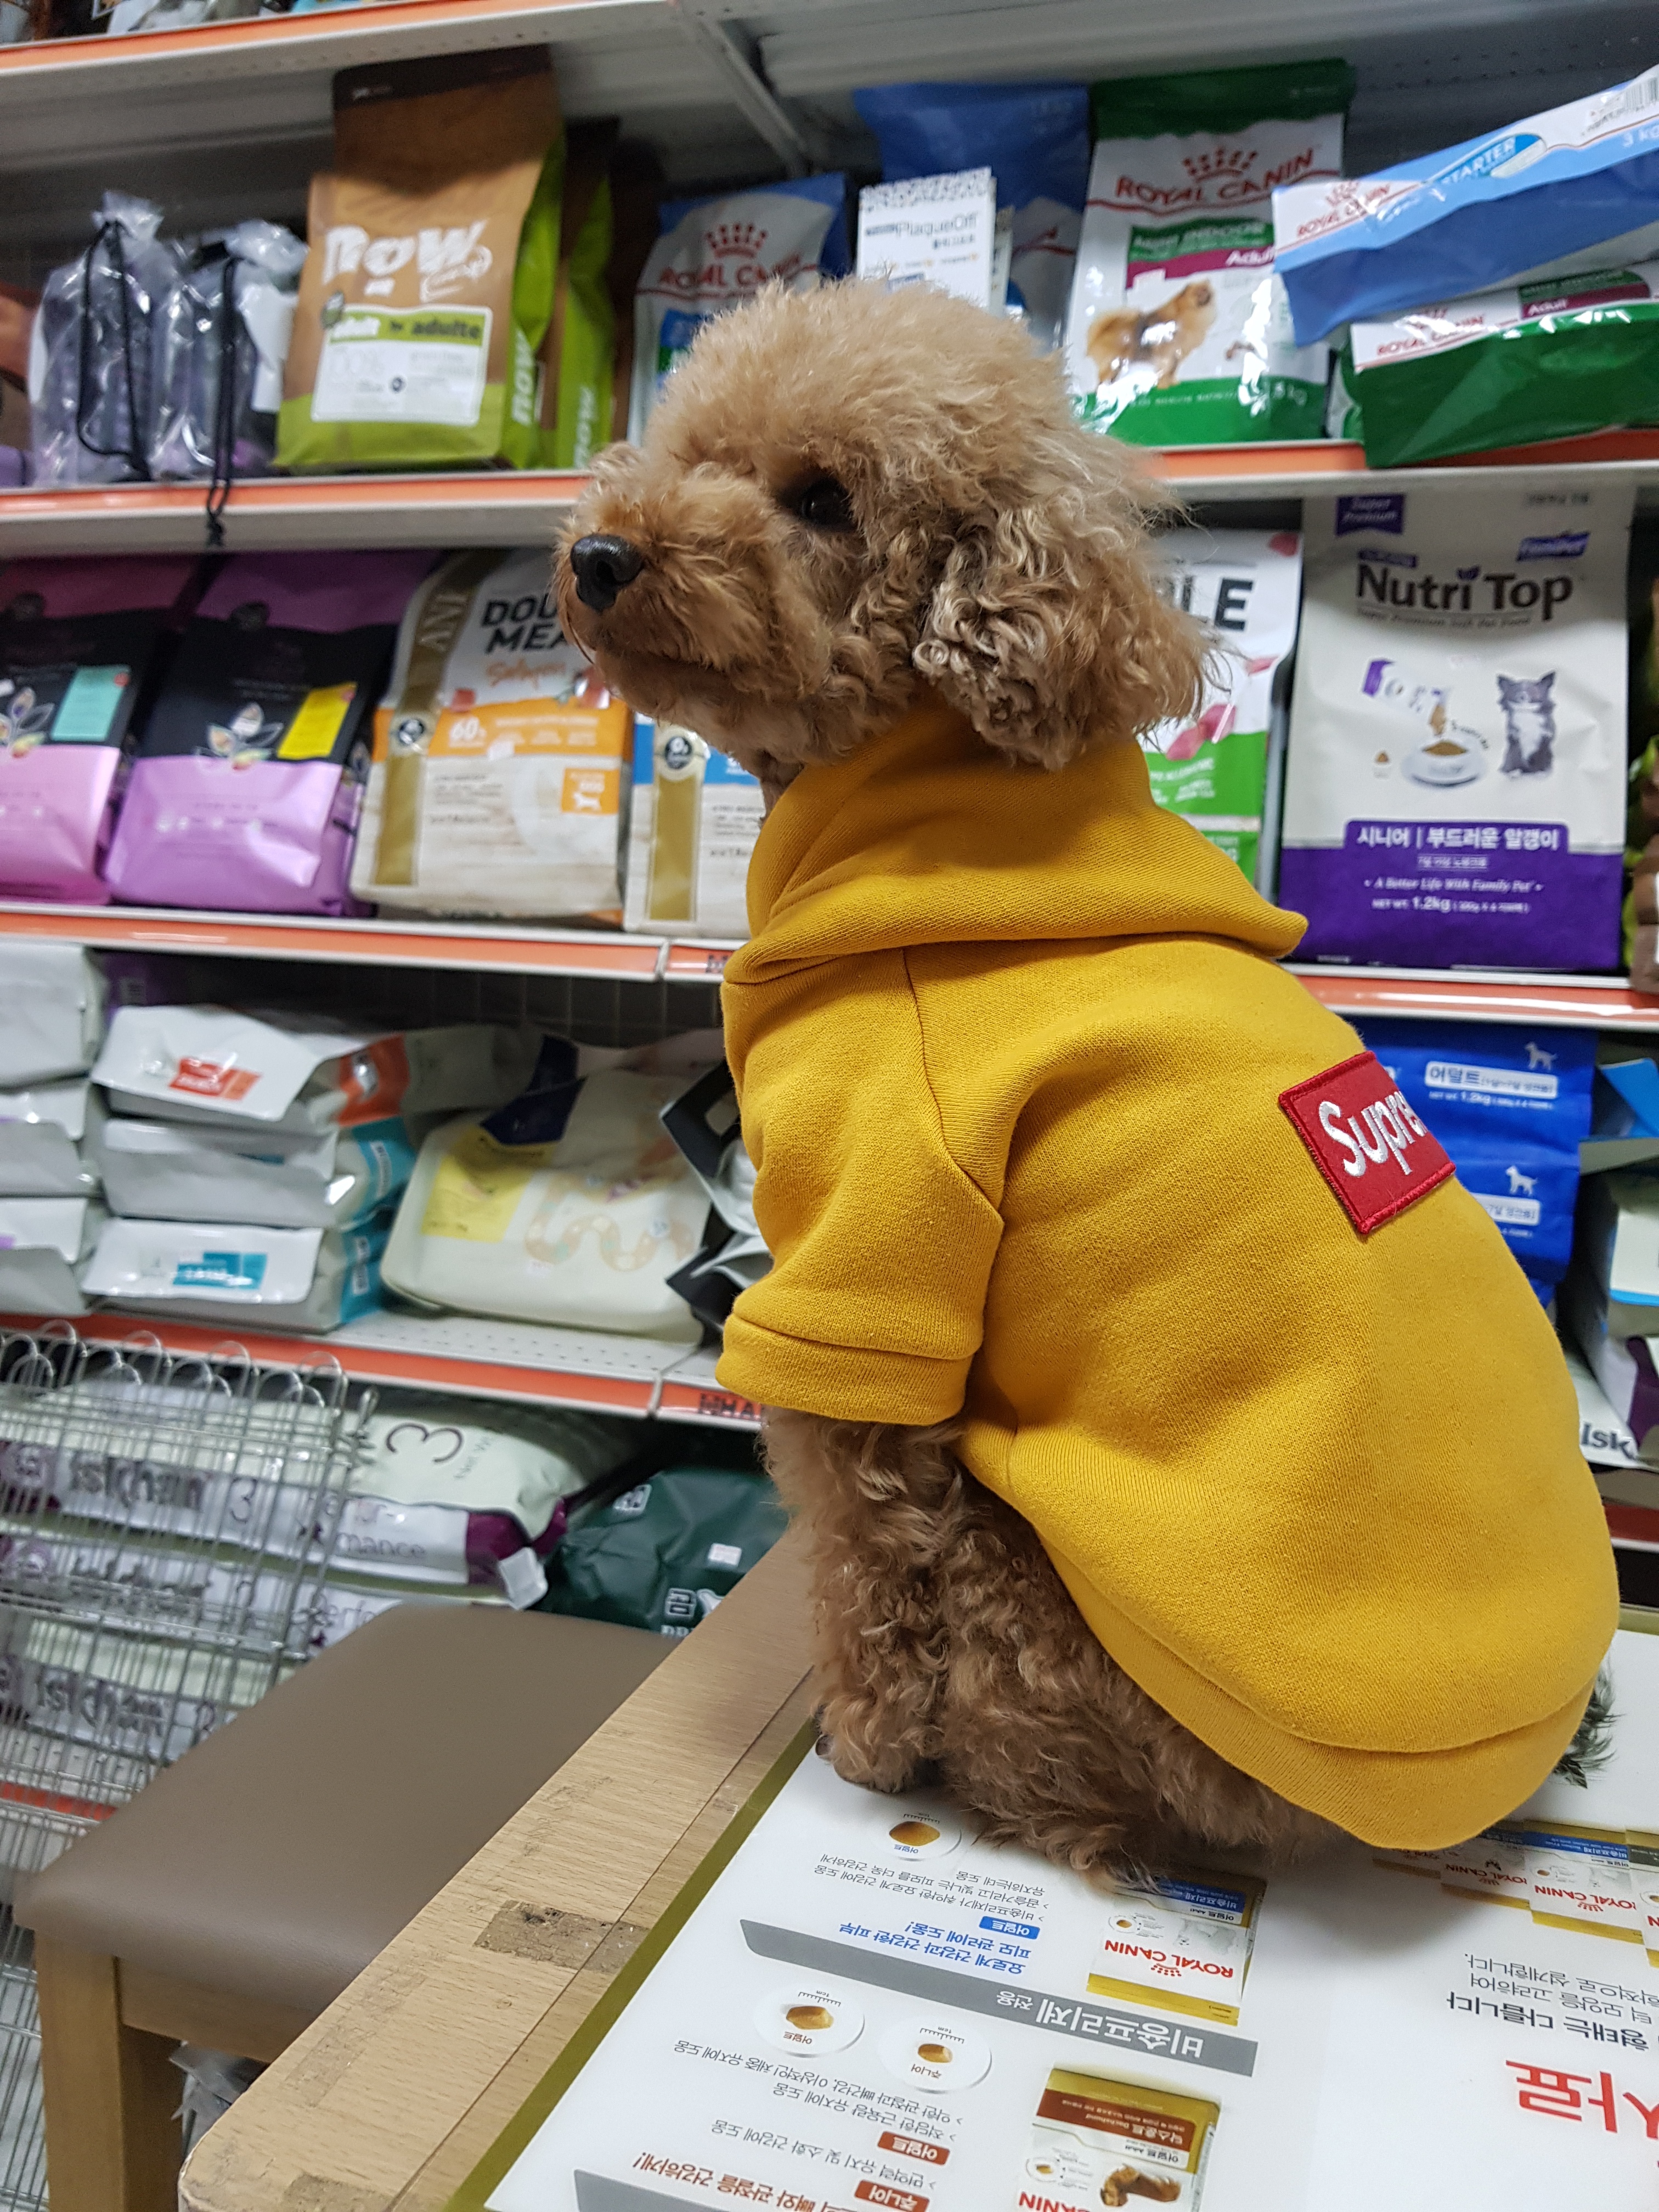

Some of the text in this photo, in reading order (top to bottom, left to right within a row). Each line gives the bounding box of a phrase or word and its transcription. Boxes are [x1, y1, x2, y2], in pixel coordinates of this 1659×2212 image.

[1217, 148, 1314, 199] CANIN
[1356, 563, 1573, 621] Nutri Top
[1357, 826, 1410, 849] 시니어
[1504, 828, 1559, 851] 알갱이
[1412, 896, 1452, 913] 1.2kg
[1429, 1066, 1481, 1085] 어덜트
[893, 1844, 919, 1854] 어덜트
[820, 1853, 1040, 1909] 곱슬거리고 빛나는 피모를 더욱 건강하게
[956, 1870, 1046, 1897] 유지하는데 도움
[1445, 1864, 1487, 1877] CANIN
[814, 1864, 1034, 1921] 비숑프리제가 취약한 요로계 건강에 도움
[1534, 1884, 1587, 1901] CANIN
[904, 1921, 1032, 1960] 피모 관리에 도움!
[991, 1920, 1031, 1937] 어덜트
[838, 1922, 1026, 1975] 요로계 건강과 건강한 피부
[1104, 1939, 1234, 1979] ROYAL CANIN
[1464, 1953, 1570, 1987] 설계합니다.
[1470, 1972, 1652, 2024] 턱 모양을 고려하여
[996, 1989, 1204, 2059] 비숑프리제 전용
[1446, 1991, 1649, 2051] 형태는 다릅니다
[674, 2040, 703, 2056] 도움
[783, 2031, 812, 2045] 어덜트
[701, 2046, 743, 2066] 유지에
[744, 2057, 774, 2073] 체중
[773, 2064, 829, 2087] 이상적인
[911, 2063, 943, 2079] 주니어
[772, 2083, 945, 2140] 적당한 근육량 유지에 도움
[877, 2092, 920, 2114] 관절과
[922, 2104, 951, 2124] 약한
[712, 2119, 924, 2189] 면역력 유지 및 소화 건강에 도움
[891, 2136, 938, 2161] 어덜트
[632, 2152, 816, 2212] 뼈와 관절을 건강하게!
[868, 2184, 918, 2212] 주니어
